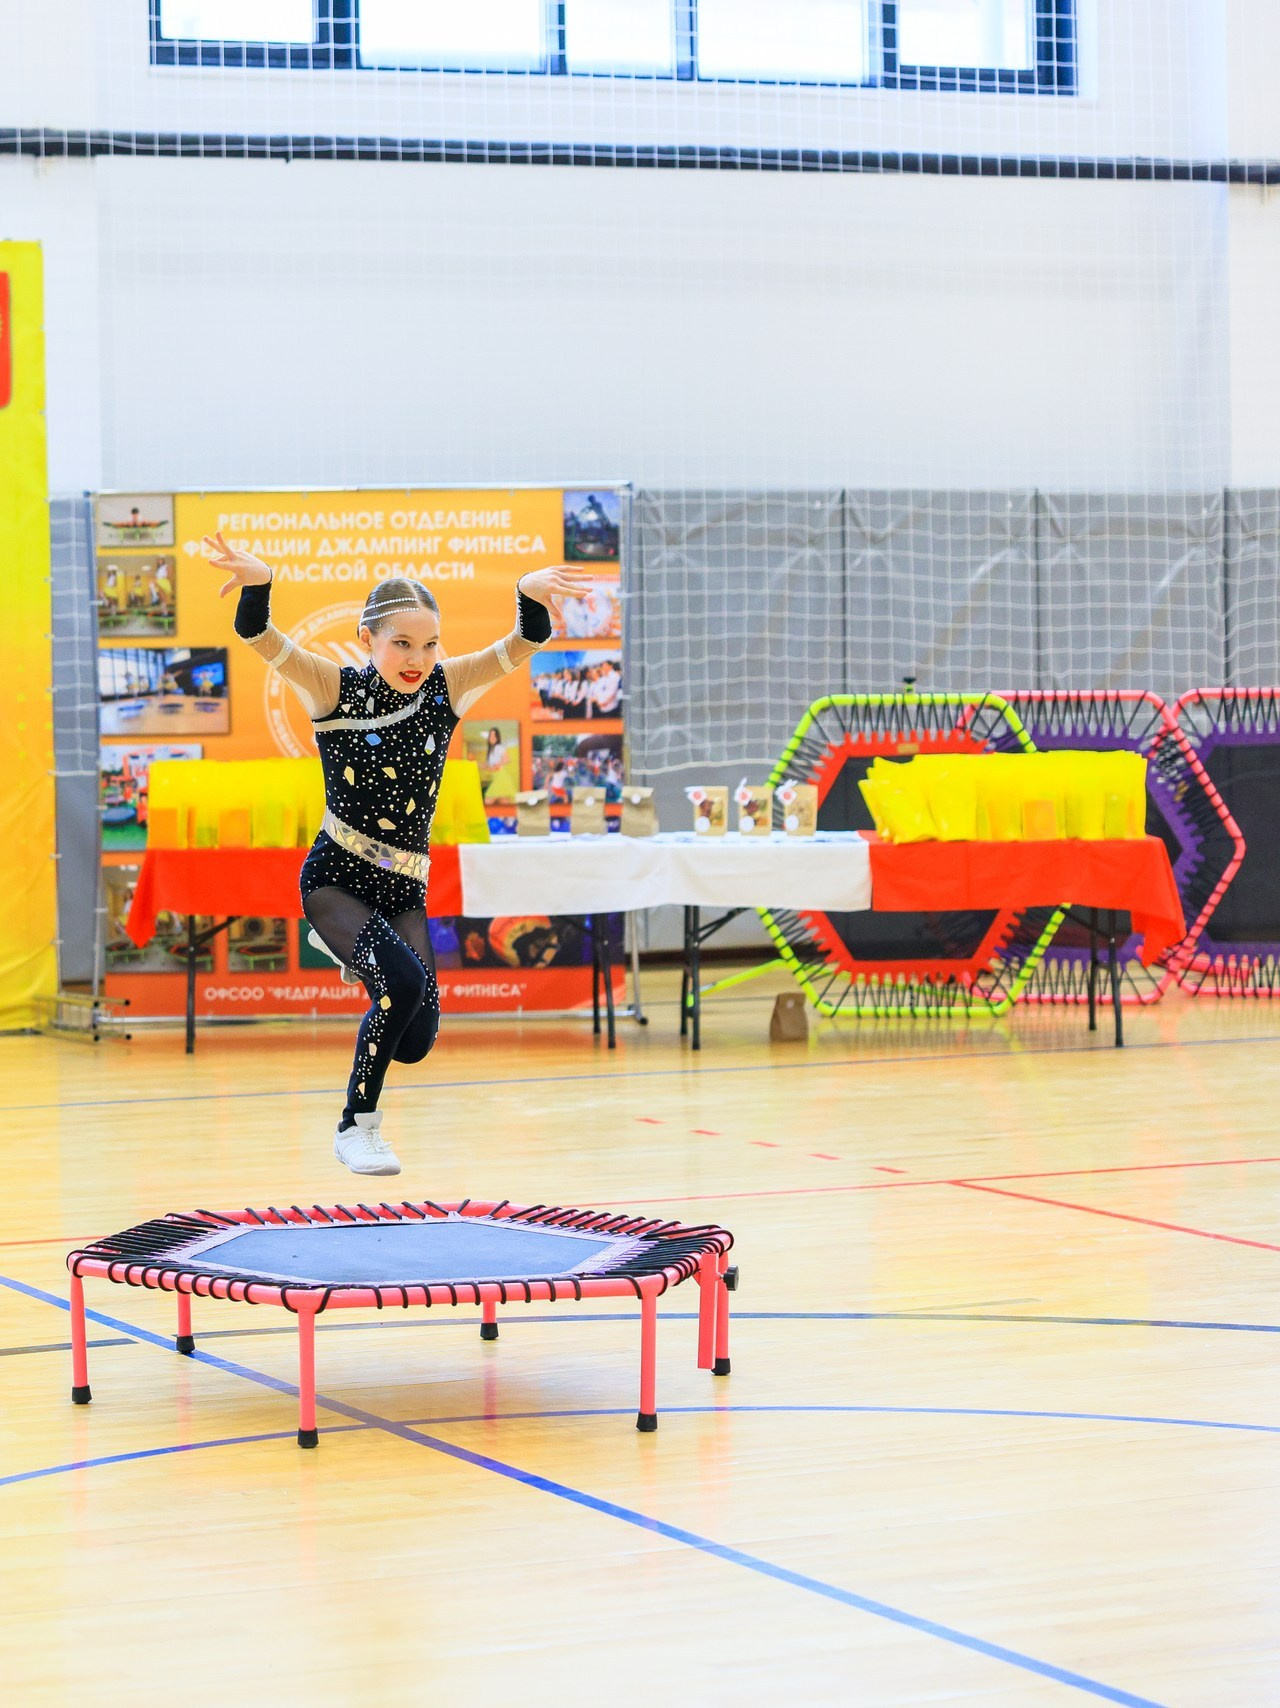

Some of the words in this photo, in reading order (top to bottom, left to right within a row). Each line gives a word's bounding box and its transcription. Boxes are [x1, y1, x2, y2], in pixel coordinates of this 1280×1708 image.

[217, 511, 386, 532] РЕГИОНАЛЬНОЕ
[390, 510, 511, 531] ОТДЕЛЕНИЕ
[316, 536, 440, 558] ДЖАМПИНГ
[447, 534, 546, 554] ФИТНЕСА
[374, 562, 474, 580] ОБЛАСТИ
